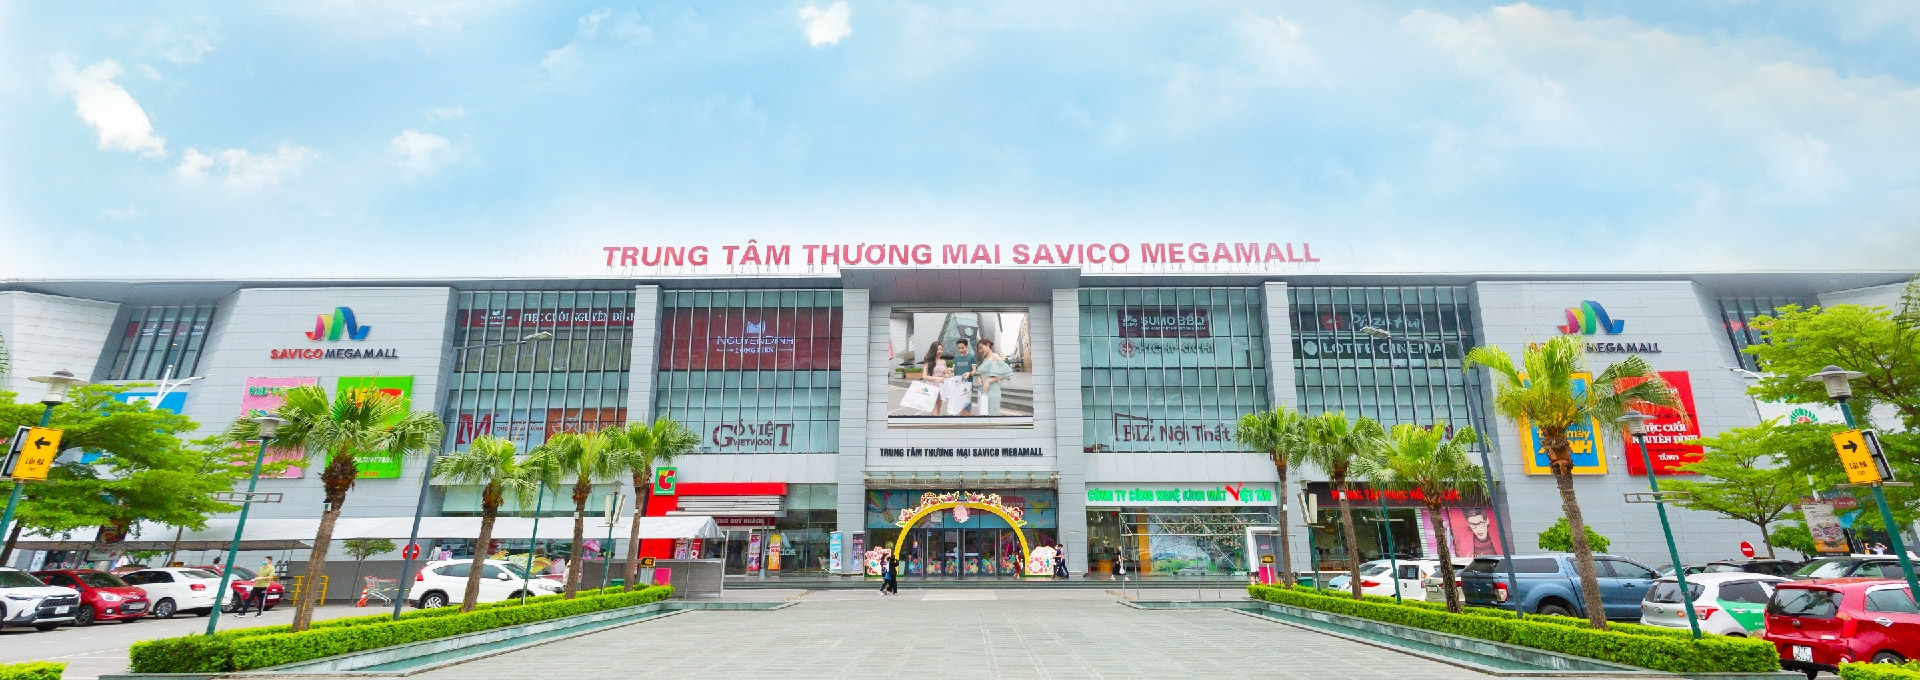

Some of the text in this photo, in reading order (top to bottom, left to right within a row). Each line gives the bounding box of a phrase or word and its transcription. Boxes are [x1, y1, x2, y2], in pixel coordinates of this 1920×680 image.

[602, 245, 710, 267] TRUNG
[722, 239, 791, 266] TÂM
[802, 242, 932, 265] THƯƠNG
[1012, 243, 1130, 264] SAVICO
[1141, 242, 1321, 263] MEGAMALL
[1140, 315, 1205, 326] SUMO BBQ
[270, 348, 399, 360] SAVICO MEGAMALL
[1322, 341, 1443, 354] LOTTE CINEMA
[1122, 424, 1155, 441] BIZ
[1159, 425, 1190, 445] Nội
[879, 446, 1044, 459] TRUNG TÂM THƯƠNG MẠI SAVICO MEGAMALL
[1088, 487, 1114, 501] CÔNG
[1115, 489, 1127, 501] TY
[1128, 487, 1155, 501] CÔNG
